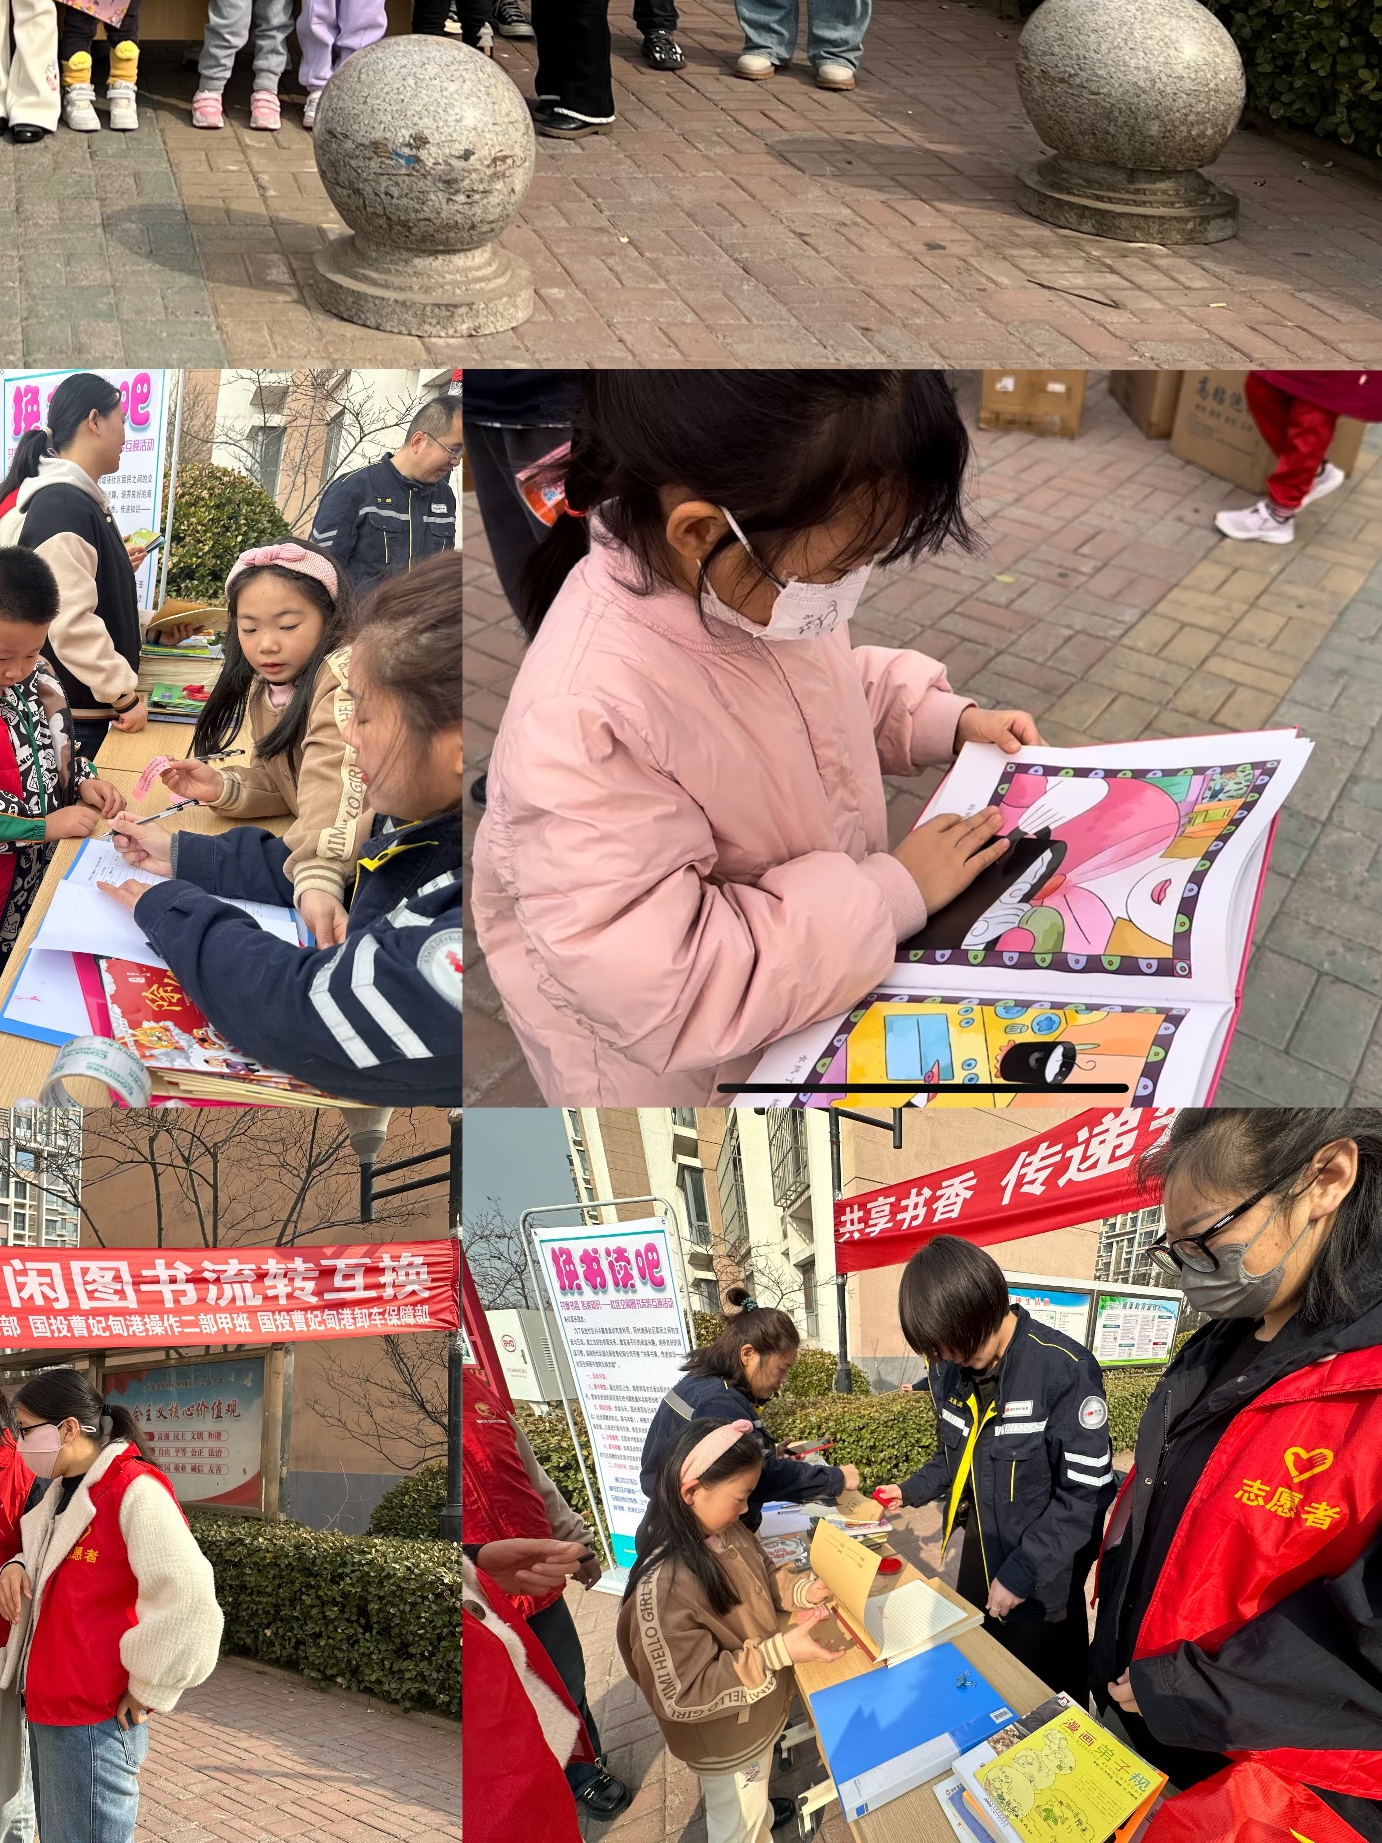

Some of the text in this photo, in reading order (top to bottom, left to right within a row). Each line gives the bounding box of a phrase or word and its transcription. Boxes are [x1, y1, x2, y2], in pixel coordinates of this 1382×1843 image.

[838, 1171, 978, 1243] 共享书香
[550, 1242, 665, 1292] 换书读吧
[29, 1309, 251, 1339] 国投曹妃甸港操作二部甲班
[257, 1303, 430, 1334] 国投曹妃甸港卸车保障部
[1234, 1478, 1341, 1531] 志愿者
[644, 1627, 668, 1671] HELLO
[708, 1690, 748, 1714] HELLO
[1062, 1718, 1151, 1793] 漫画弟子规
